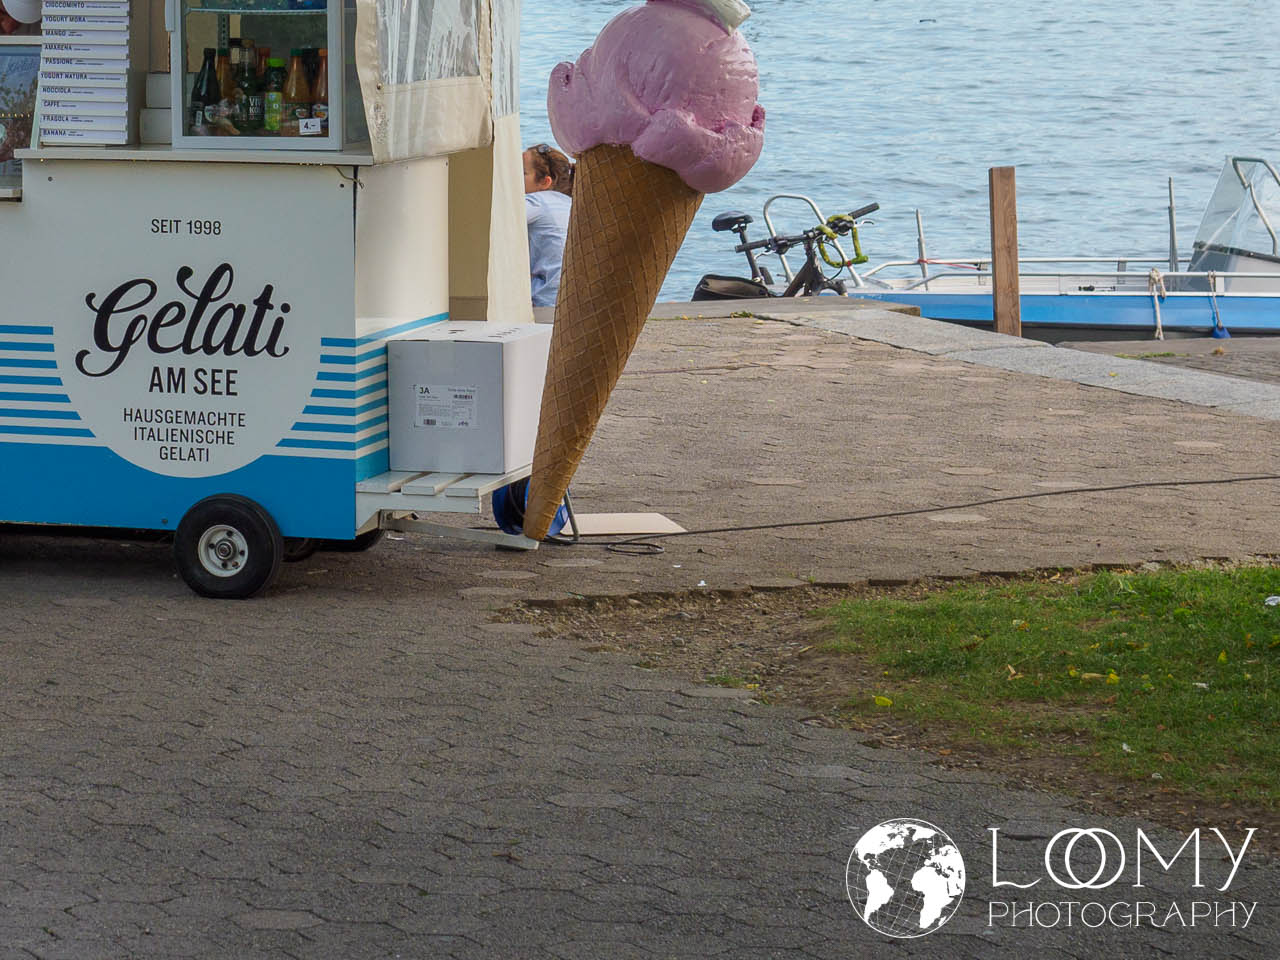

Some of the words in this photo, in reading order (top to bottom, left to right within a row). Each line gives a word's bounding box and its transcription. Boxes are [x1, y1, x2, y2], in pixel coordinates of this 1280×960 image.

[151, 218, 182, 234] SEIT
[186, 220, 222, 236] 1998
[75, 262, 291, 378] Gelati
[148, 366, 186, 394] AM
[193, 367, 238, 396] SEE
[123, 407, 246, 428] HAUSGEMACHTE
[133, 426, 235, 446] ITALIENISCHE
[159, 446, 210, 463] GELATI
